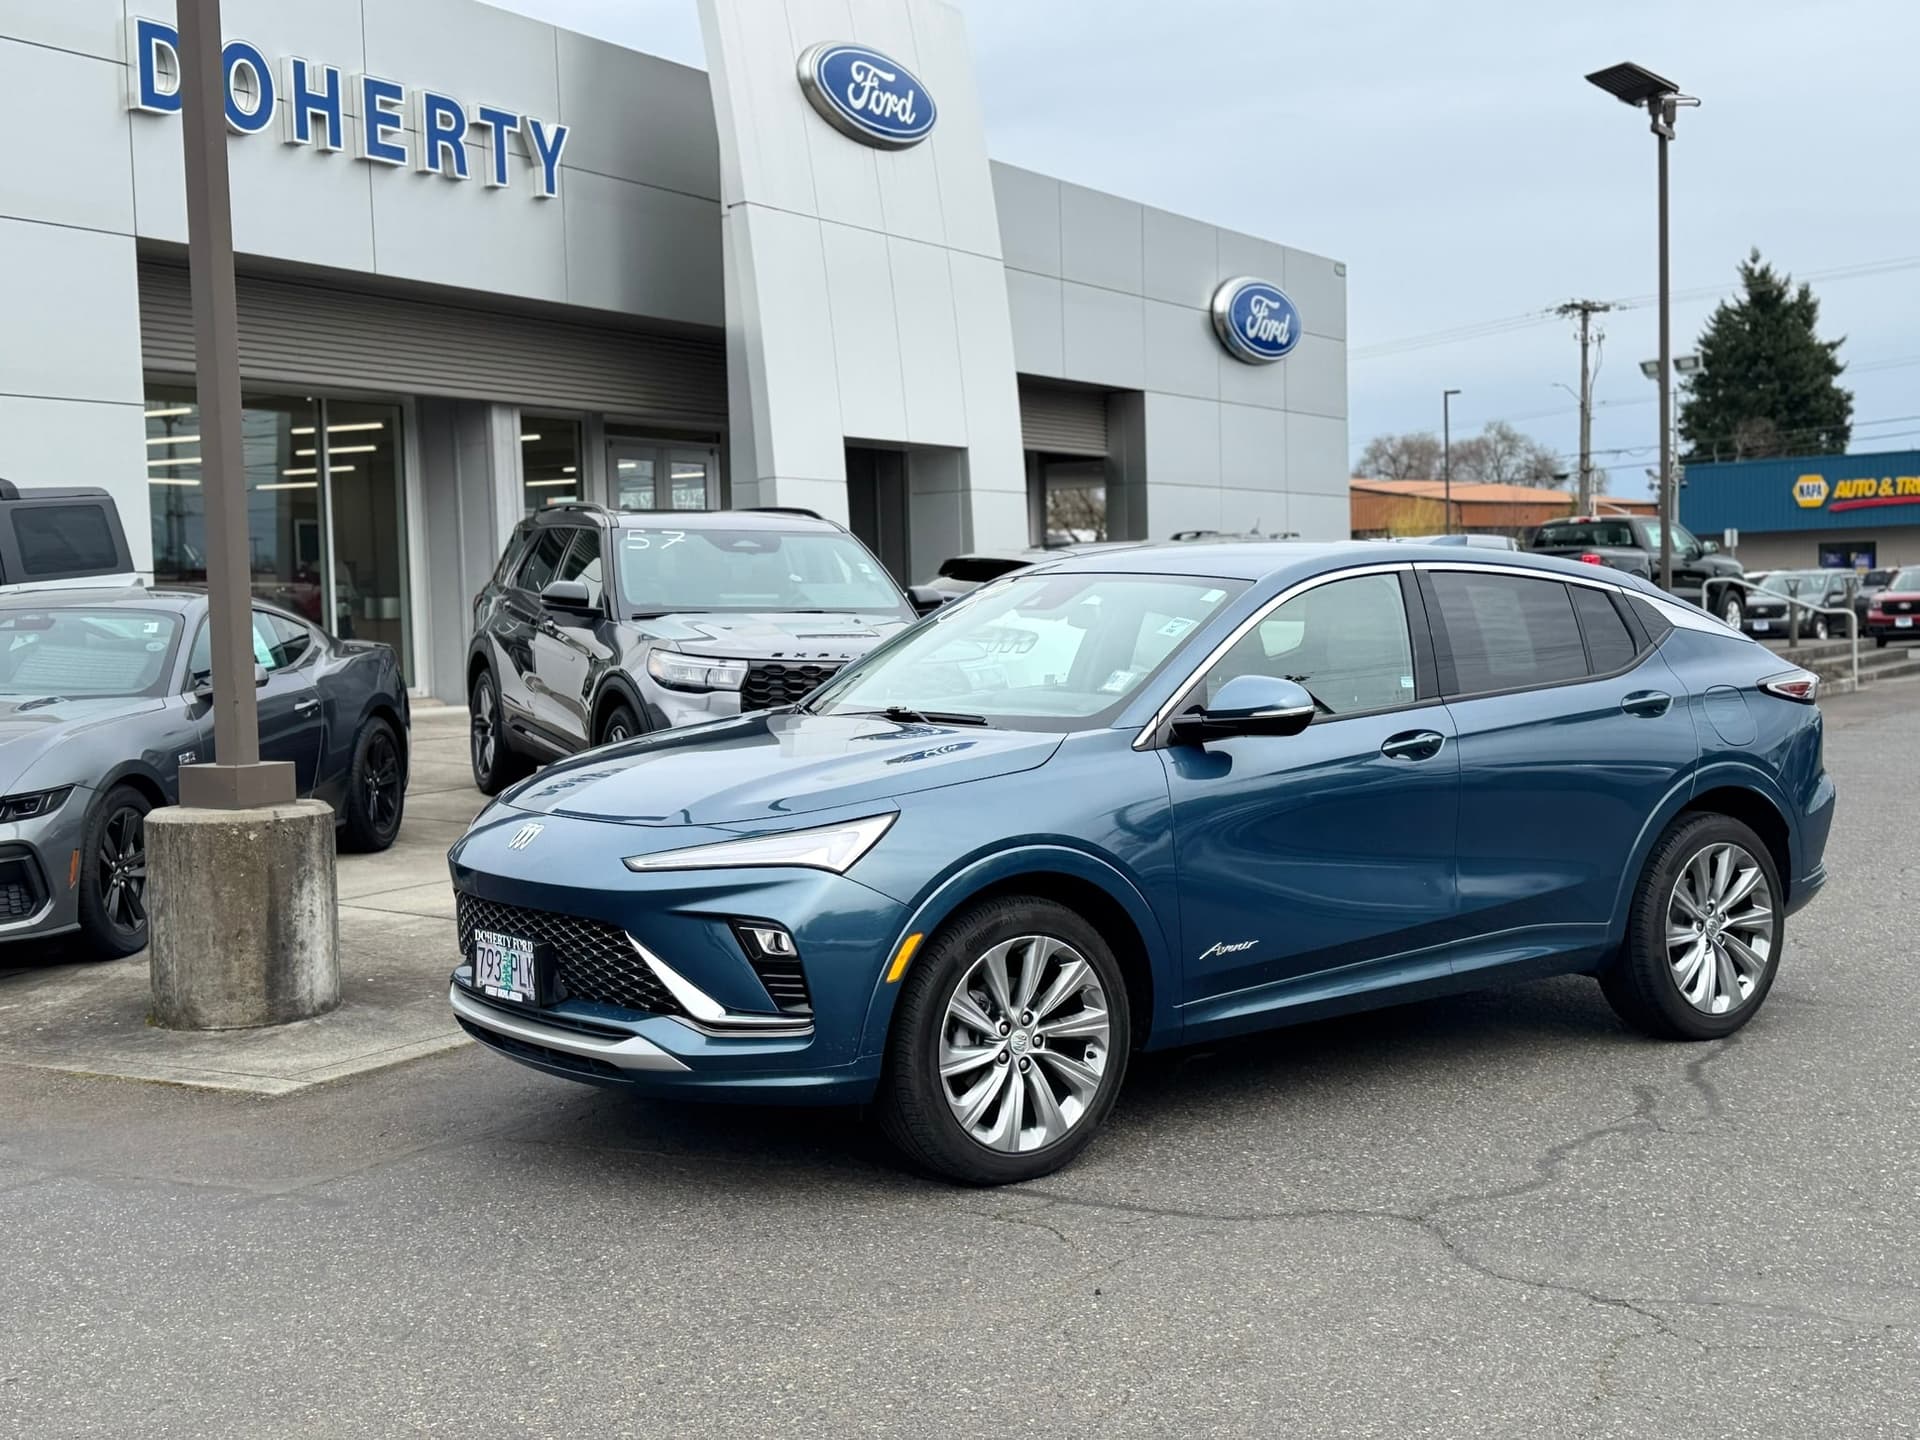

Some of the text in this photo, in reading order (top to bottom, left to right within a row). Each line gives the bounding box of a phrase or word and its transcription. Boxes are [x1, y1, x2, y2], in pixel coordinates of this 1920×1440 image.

[129, 16, 570, 198] DOHERTY
[847, 60, 916, 125] Ford
[1245, 294, 1291, 345] Ford
[1799, 483, 1823, 498] NAPA
[1833, 478, 1877, 499] AUTO
[1878, 477, 1895, 497] &
[475, 929, 533, 953] DOHERTY FORD
[477, 947, 535, 989] 793 PLK
